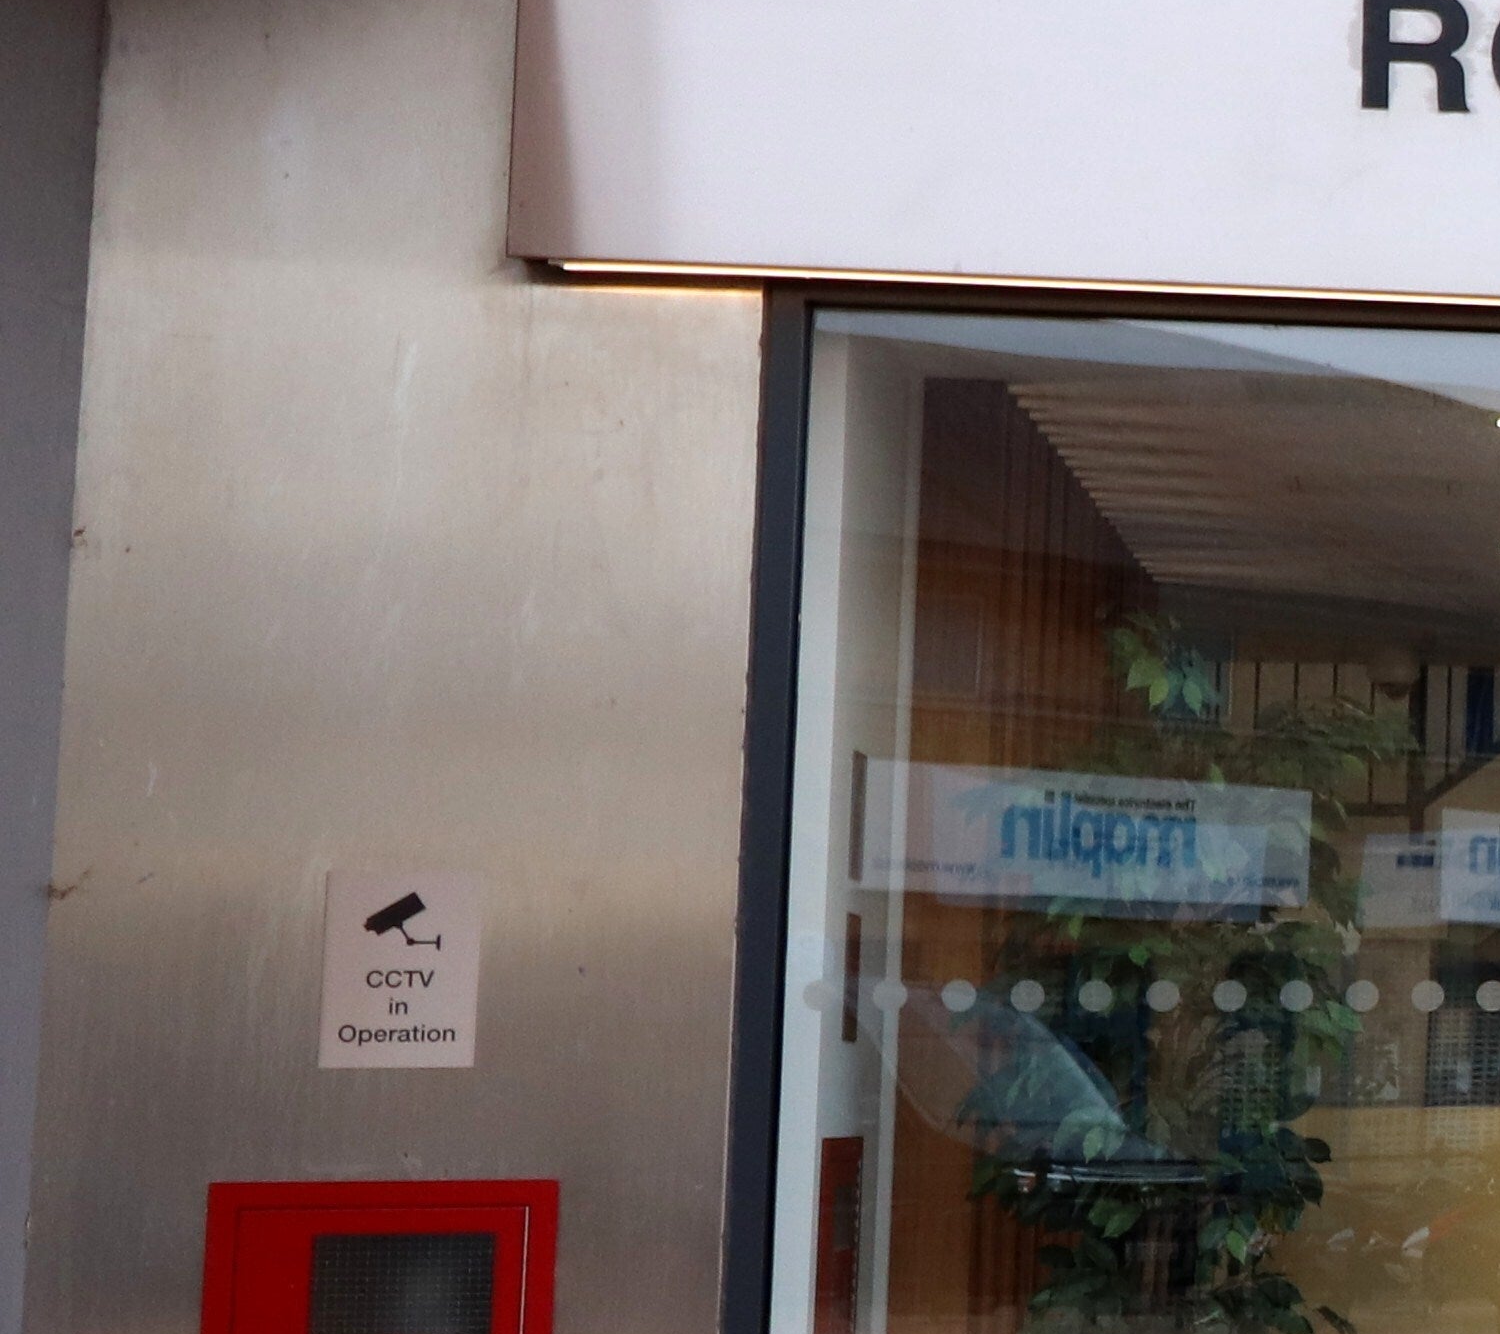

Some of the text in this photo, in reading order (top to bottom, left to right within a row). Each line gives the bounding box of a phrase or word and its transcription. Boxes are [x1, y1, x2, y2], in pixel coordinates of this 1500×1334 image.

[366, 969, 435, 989] CCTV
[388, 996, 409, 1016] in
[337, 1023, 457, 1047] Operation
